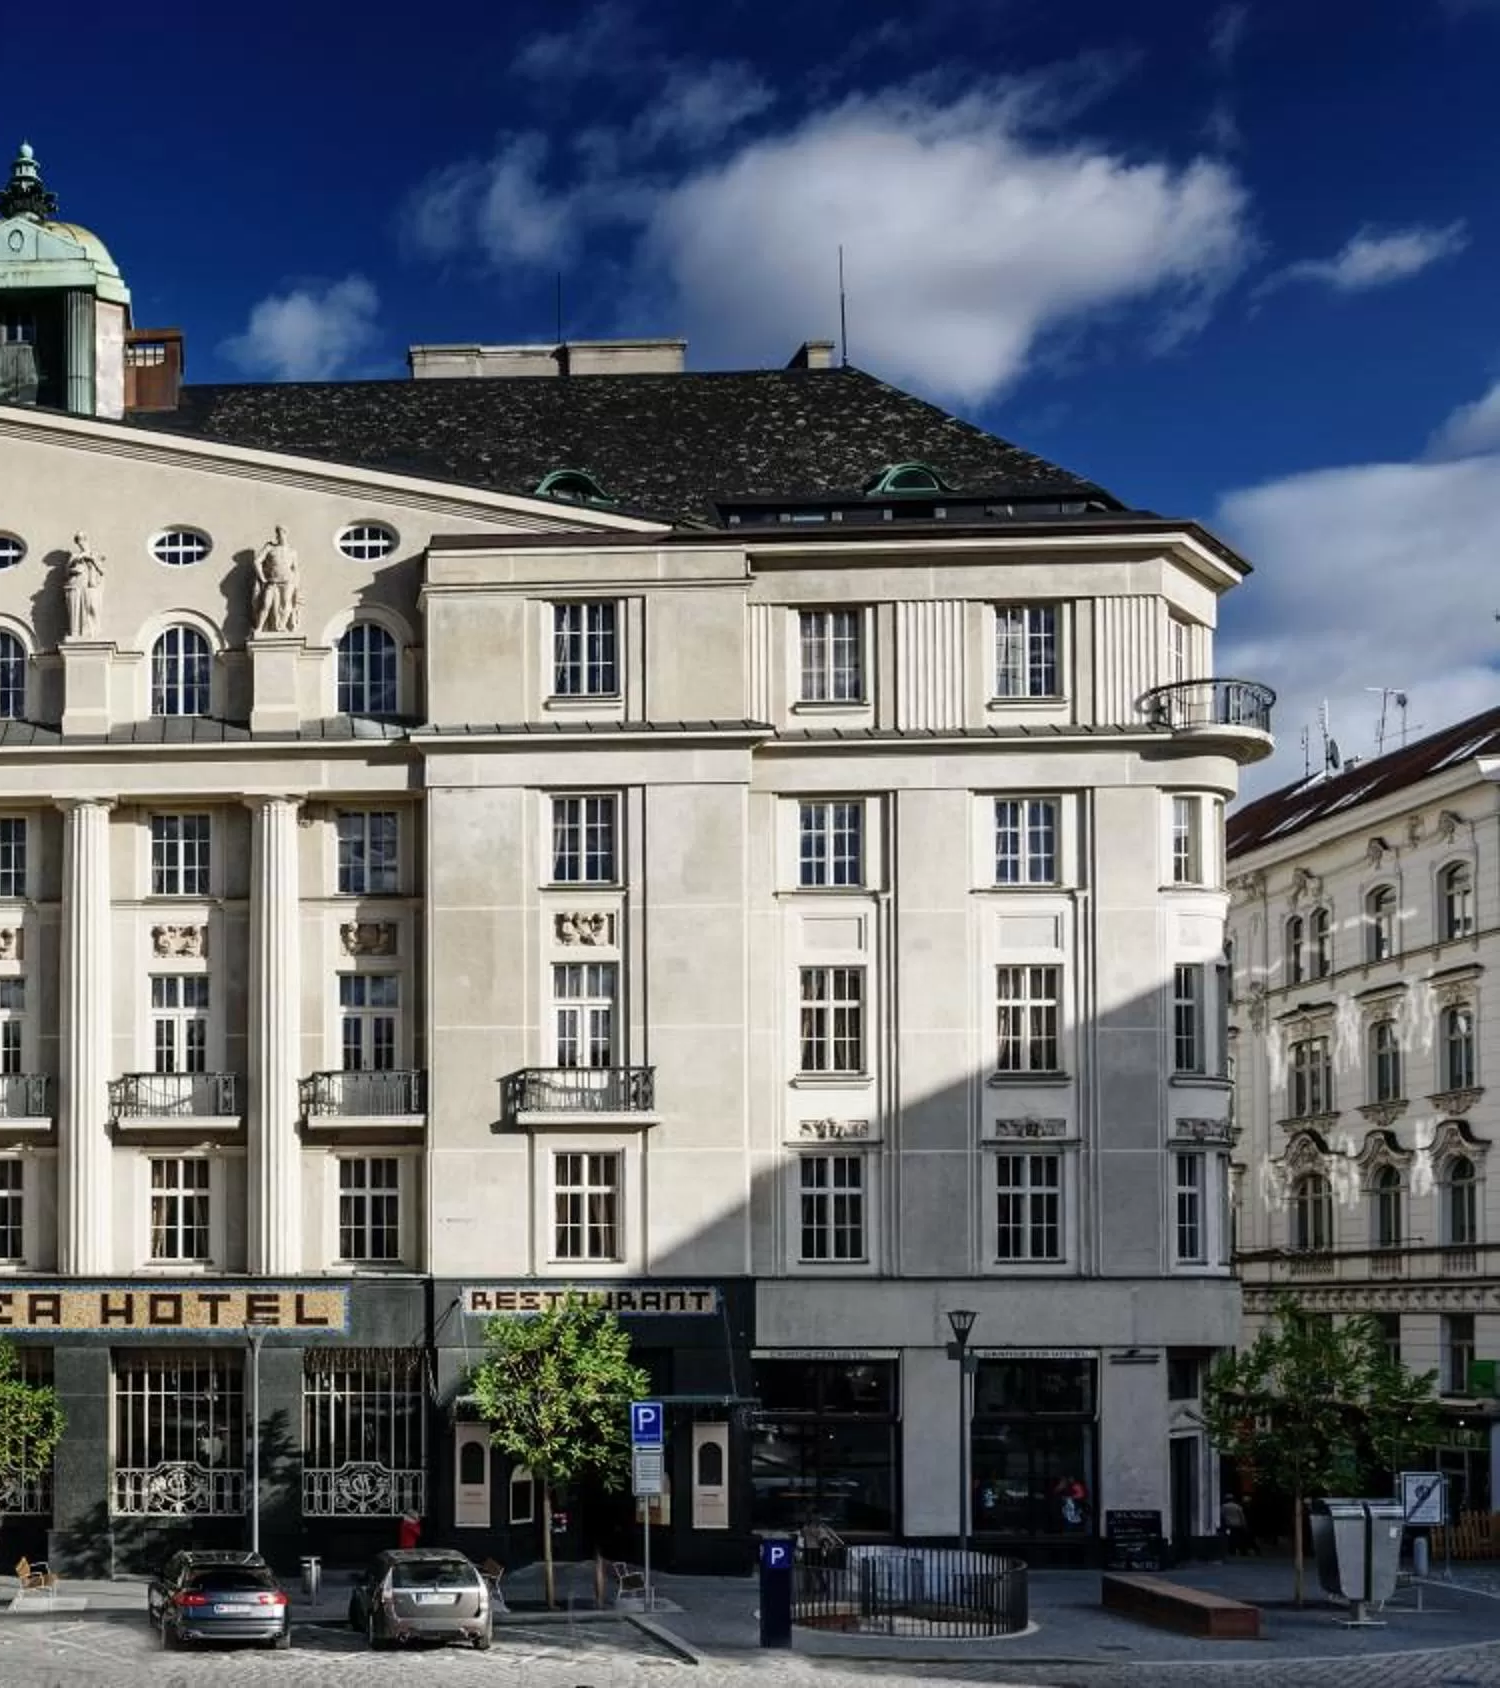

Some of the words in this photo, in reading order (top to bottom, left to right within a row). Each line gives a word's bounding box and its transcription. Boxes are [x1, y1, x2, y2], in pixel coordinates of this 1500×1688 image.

[100, 1293, 329, 1325] HOTEL
[638, 1407, 655, 1431] P
[771, 1547, 785, 1565] P
